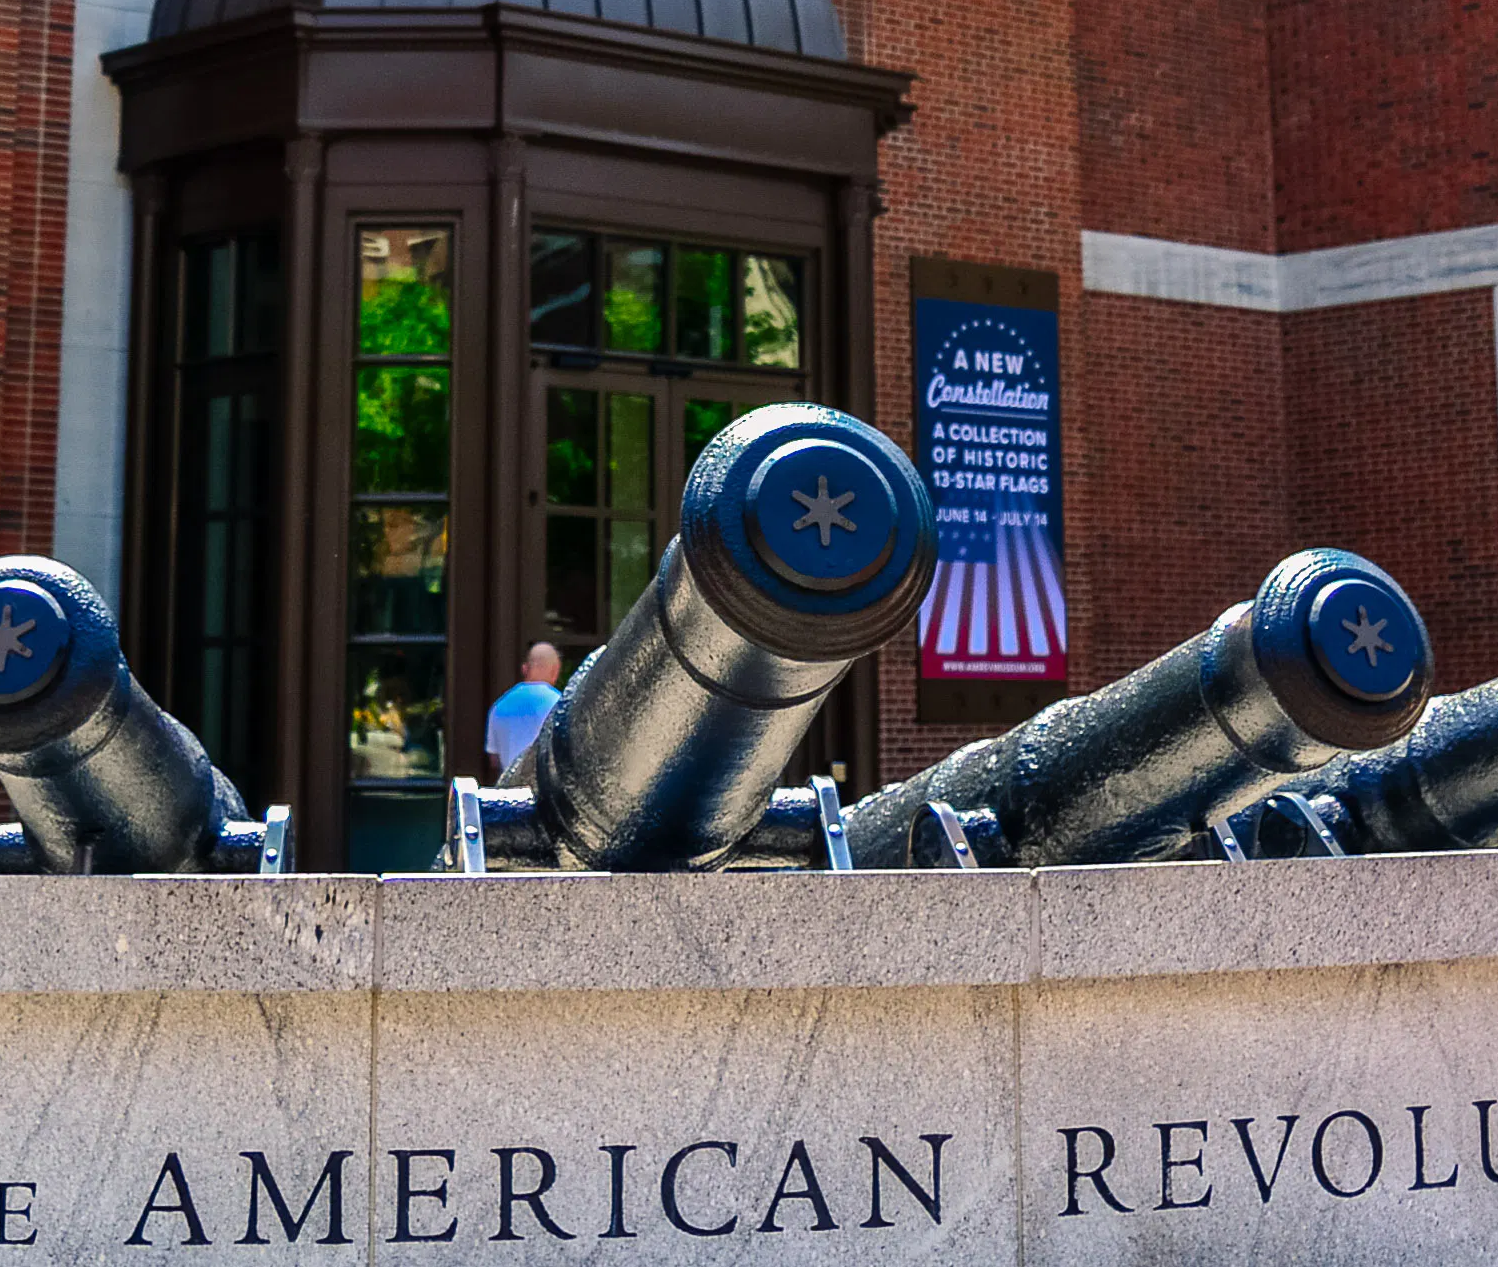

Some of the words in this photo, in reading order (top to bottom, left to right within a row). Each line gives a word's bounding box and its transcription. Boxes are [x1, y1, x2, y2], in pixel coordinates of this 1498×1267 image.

[954, 348, 968, 370] A
[975, 351, 1024, 375] NEW
[927, 374, 1049, 410] Constellation
[932, 422, 945, 439] A
[949, 424, 1047, 447] COLLECTION
[932, 446, 956, 463] OF
[964, 449, 1048, 470] HISTORIC
[933, 471, 996, 491] 13-STAR
[1001, 475, 1049, 494] FLAGS
[936, 507, 969, 523] JUNE
[999, 512, 1030, 526] JULY
[123, 1133, 954, 1246] AMERICAN
